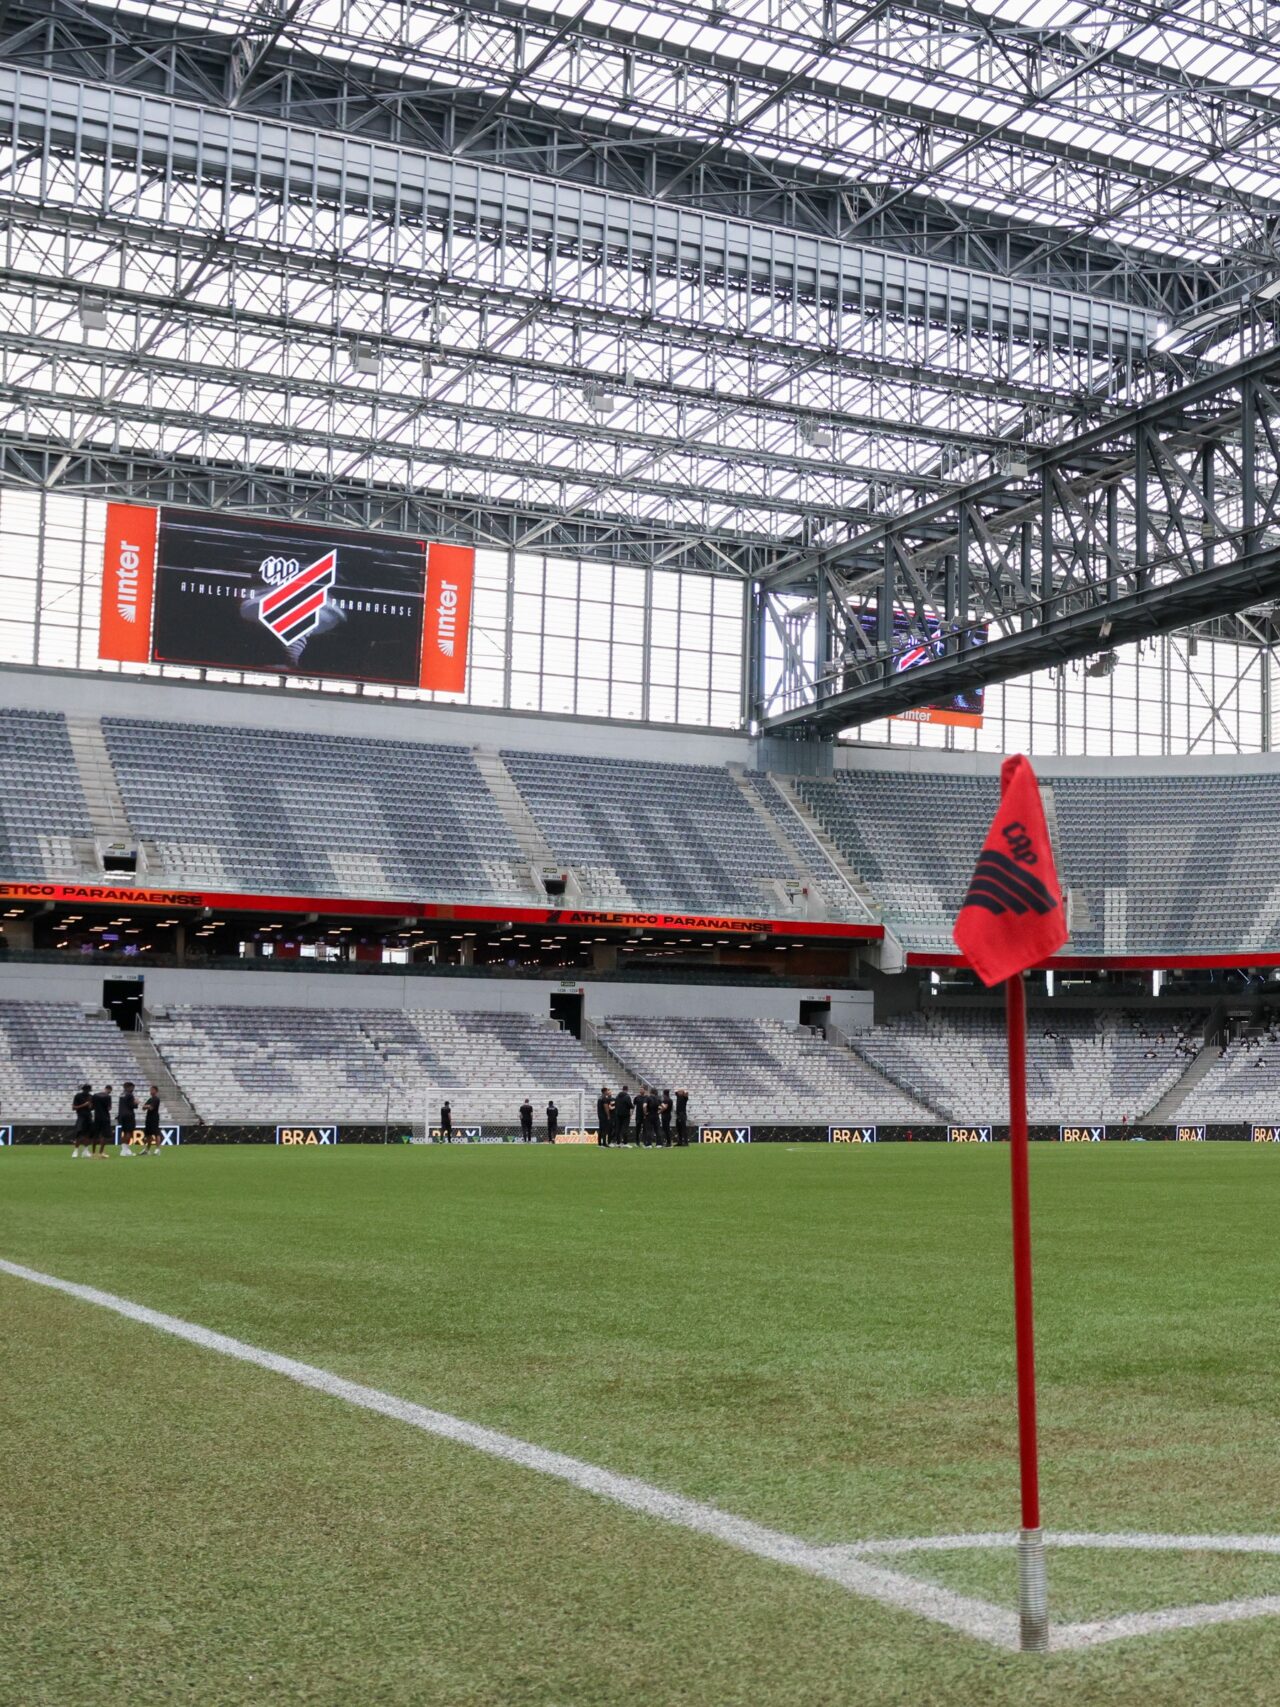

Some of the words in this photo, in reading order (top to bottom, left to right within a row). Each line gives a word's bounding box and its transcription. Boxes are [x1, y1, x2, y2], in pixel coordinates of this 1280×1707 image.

[116, 540, 140, 602] inter
[181, 582, 255, 599] ATHLETICO
[332, 598, 412, 617] PARANAENSE
[436, 580, 458, 637] inter
[63, 887, 203, 906] PARANAENSE
[570, 913, 658, 924] ATHLETICO
[663, 916, 774, 932] PARANAENSE
[282, 1129, 331, 1145] BRAX
[703, 1130, 745, 1144] BRAX
[833, 1129, 872, 1143] BRAX
[951, 1129, 988, 1143] BRAX
[1064, 1129, 1101, 1142] BRAX
[1179, 1128, 1203, 1142] BRAX
[1254, 1128, 1280, 1142] BRAX
